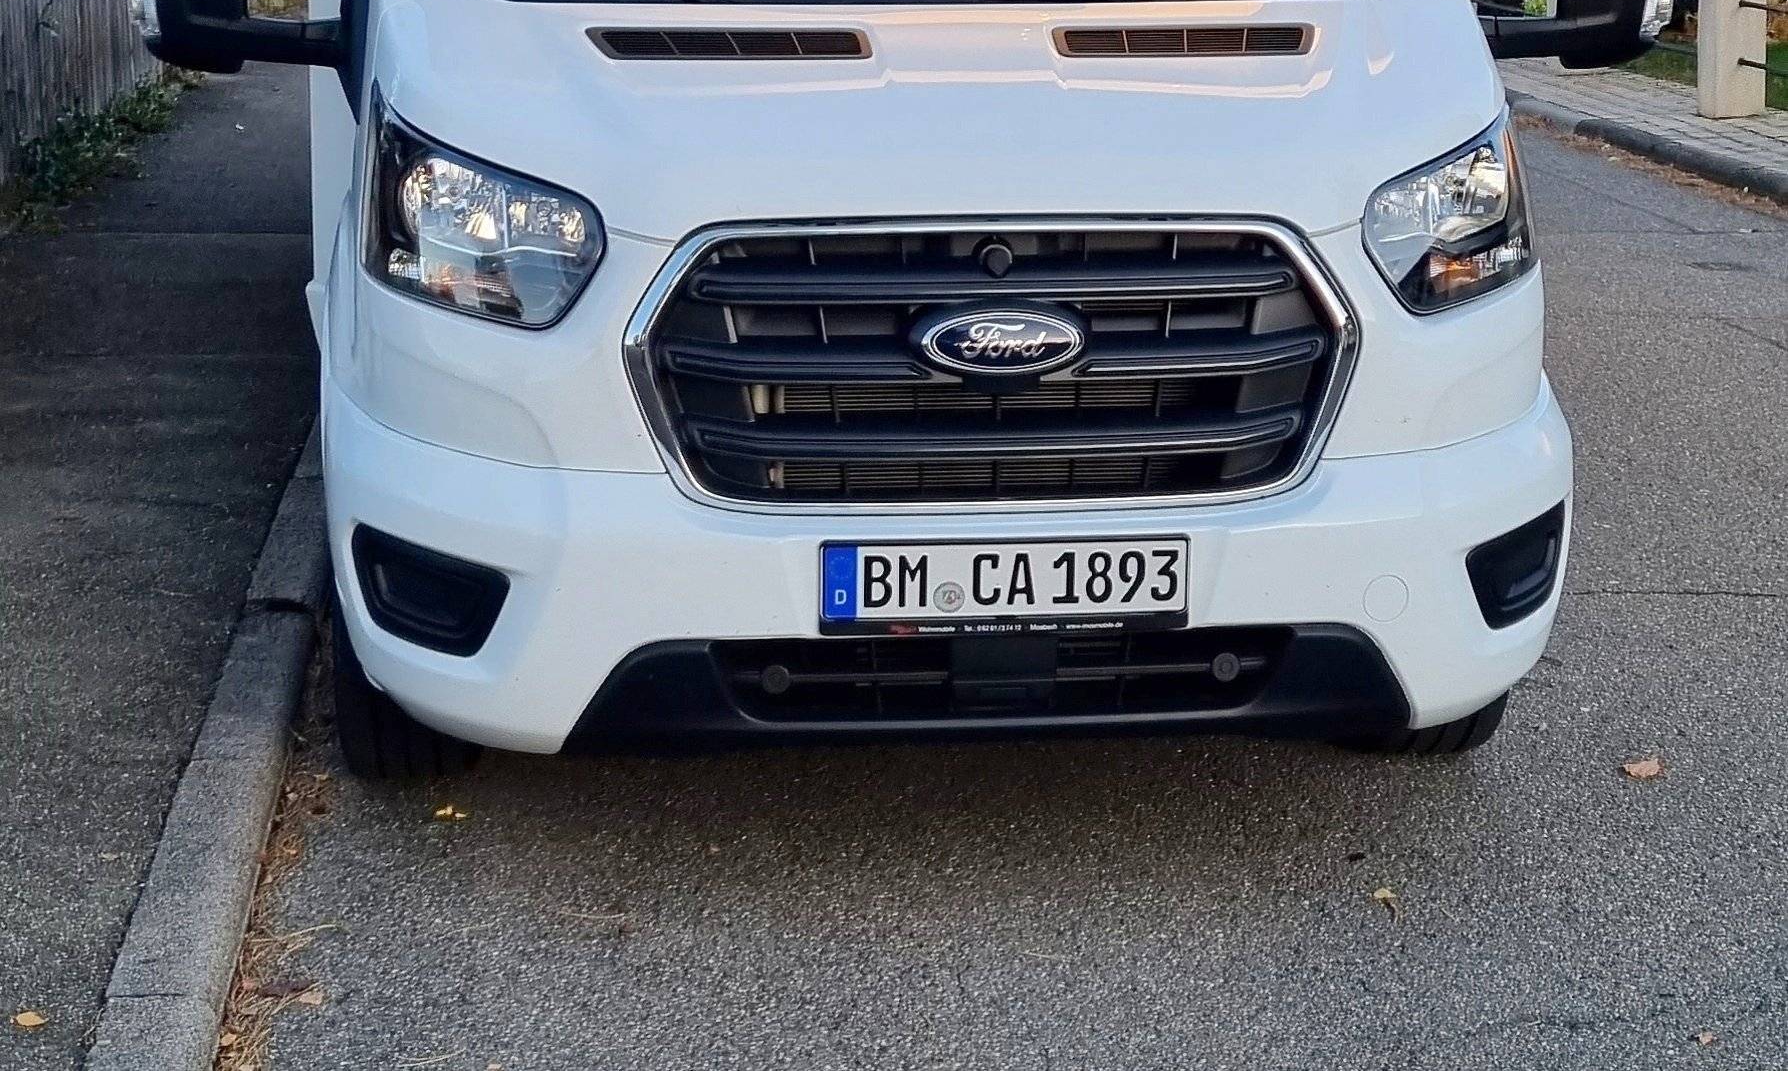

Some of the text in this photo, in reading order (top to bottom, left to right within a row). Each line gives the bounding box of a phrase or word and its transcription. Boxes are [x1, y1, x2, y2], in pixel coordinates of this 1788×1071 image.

[953, 322, 1047, 359] Ford
[834, 549, 1180, 608] D BM CA 1893
